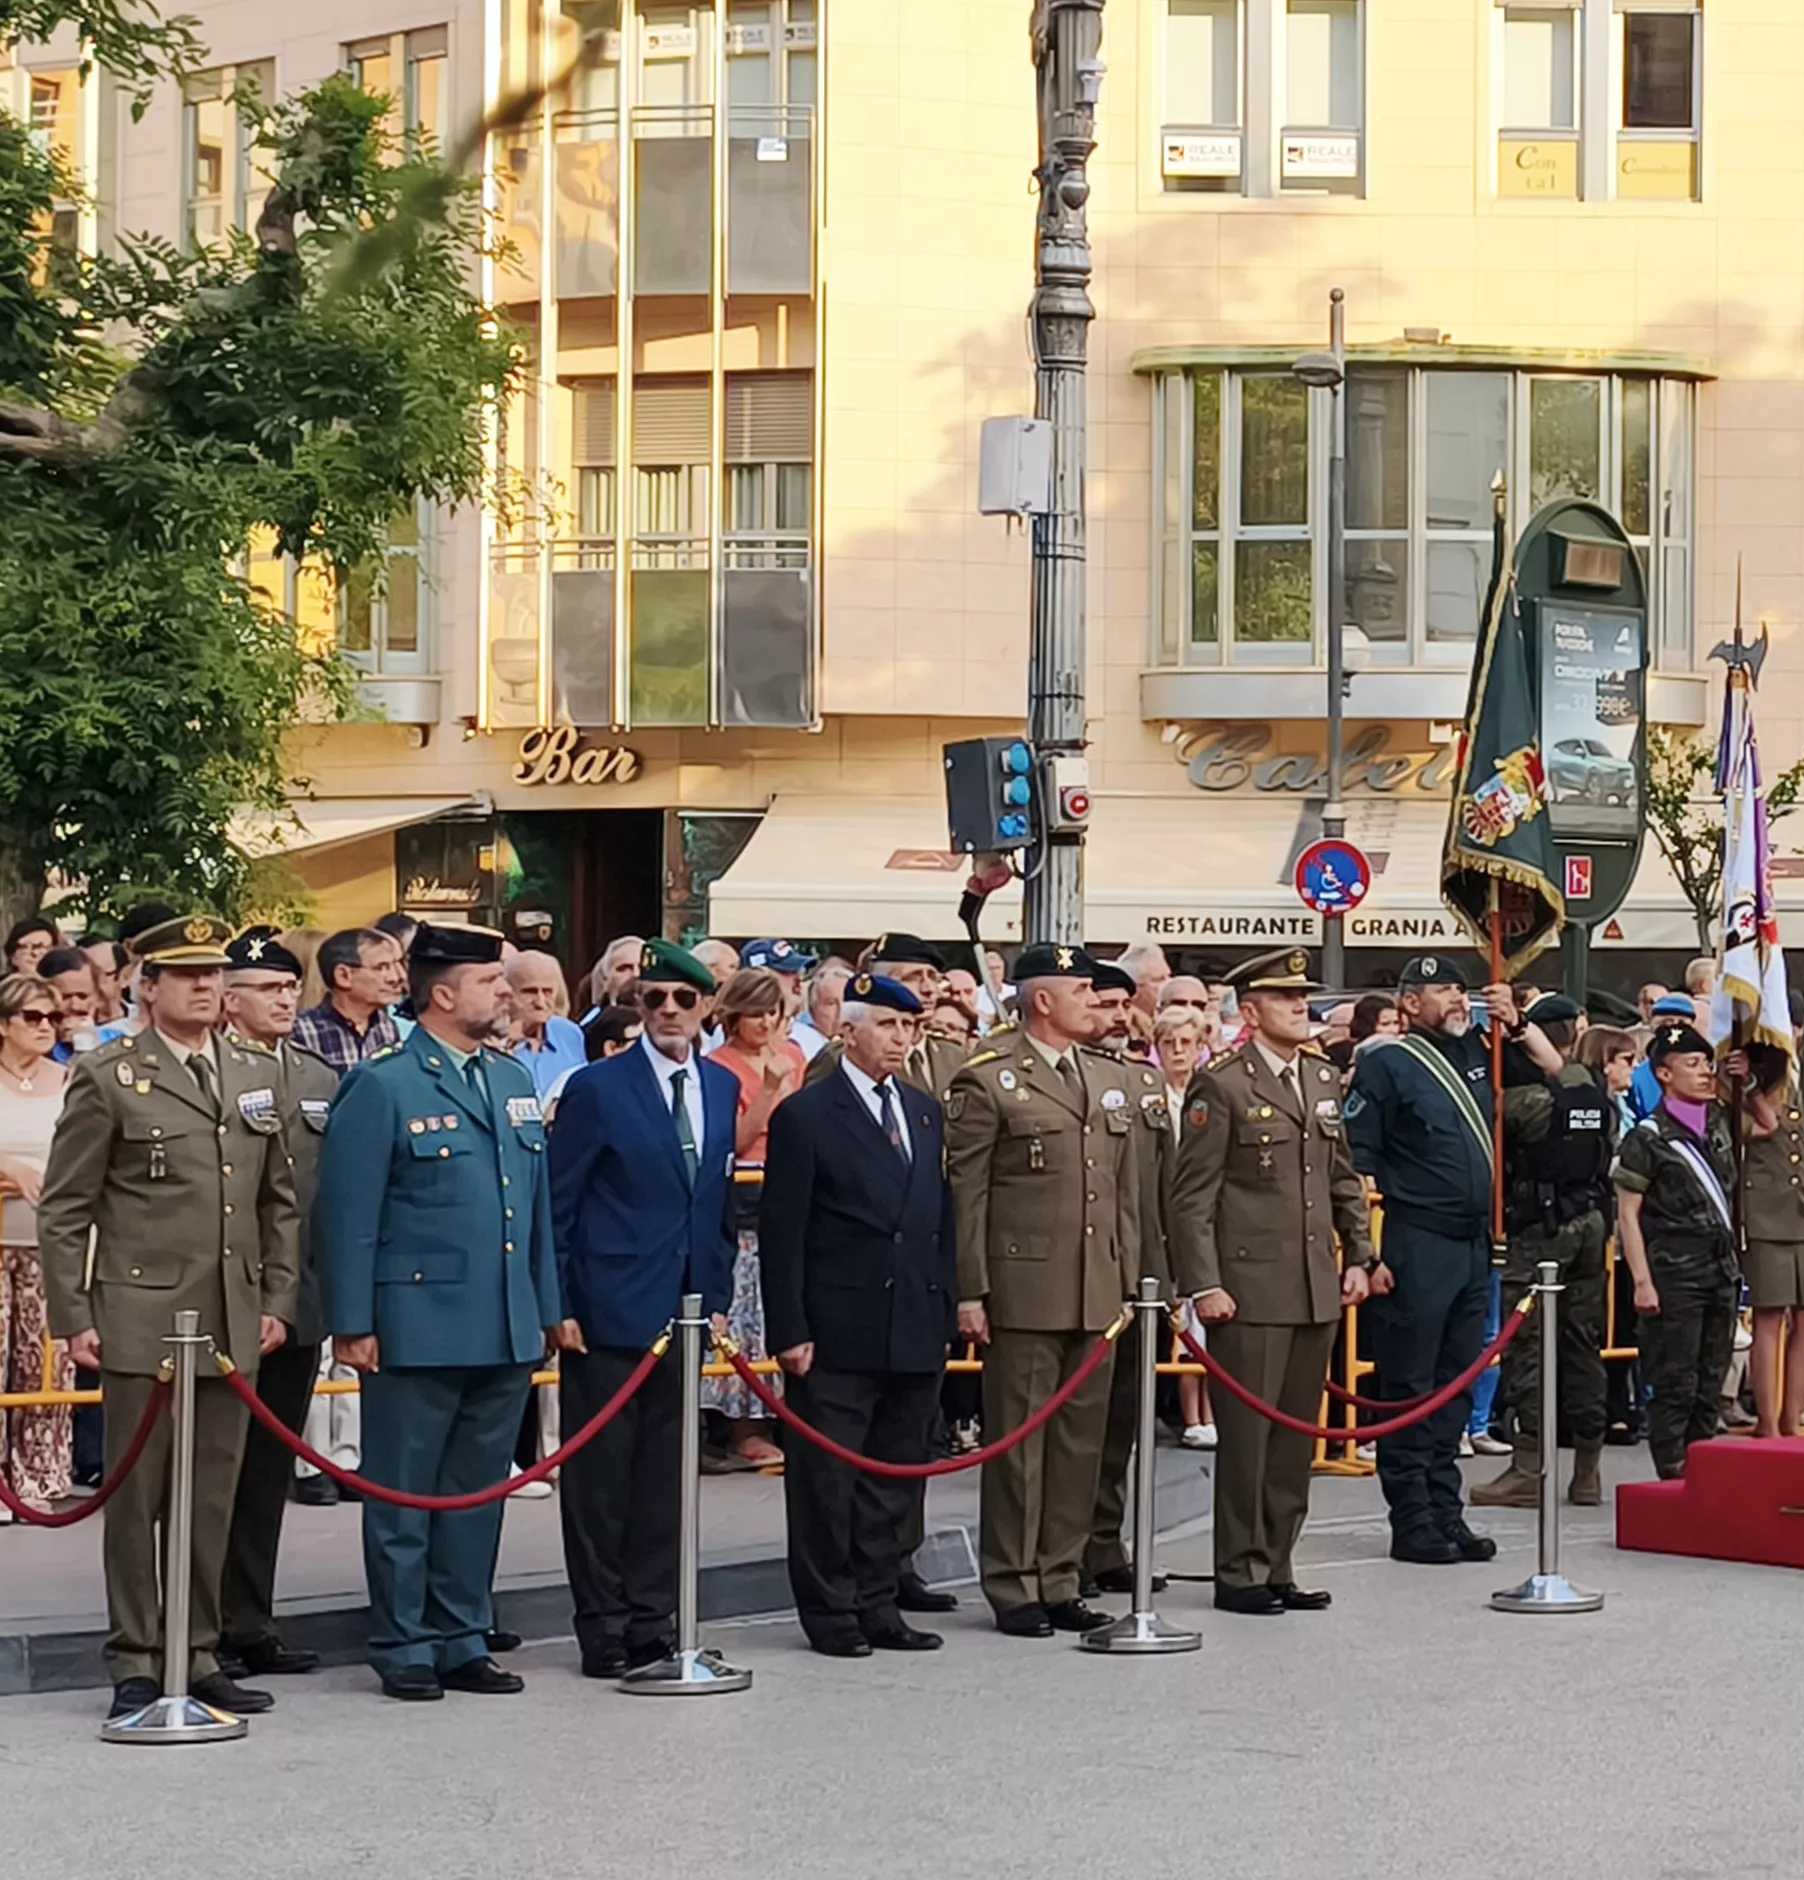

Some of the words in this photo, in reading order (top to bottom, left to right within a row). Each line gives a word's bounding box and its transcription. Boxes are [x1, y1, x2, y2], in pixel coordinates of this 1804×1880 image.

[1188, 144, 1235, 155] REALE
[1307, 145, 1353, 156] REALE
[1515, 145, 1557, 171] Con
[512, 726, 638, 785] Bar
[1146, 916, 1315, 936] RESTAURANTE
[1351, 918, 1445, 938] GRANJA
